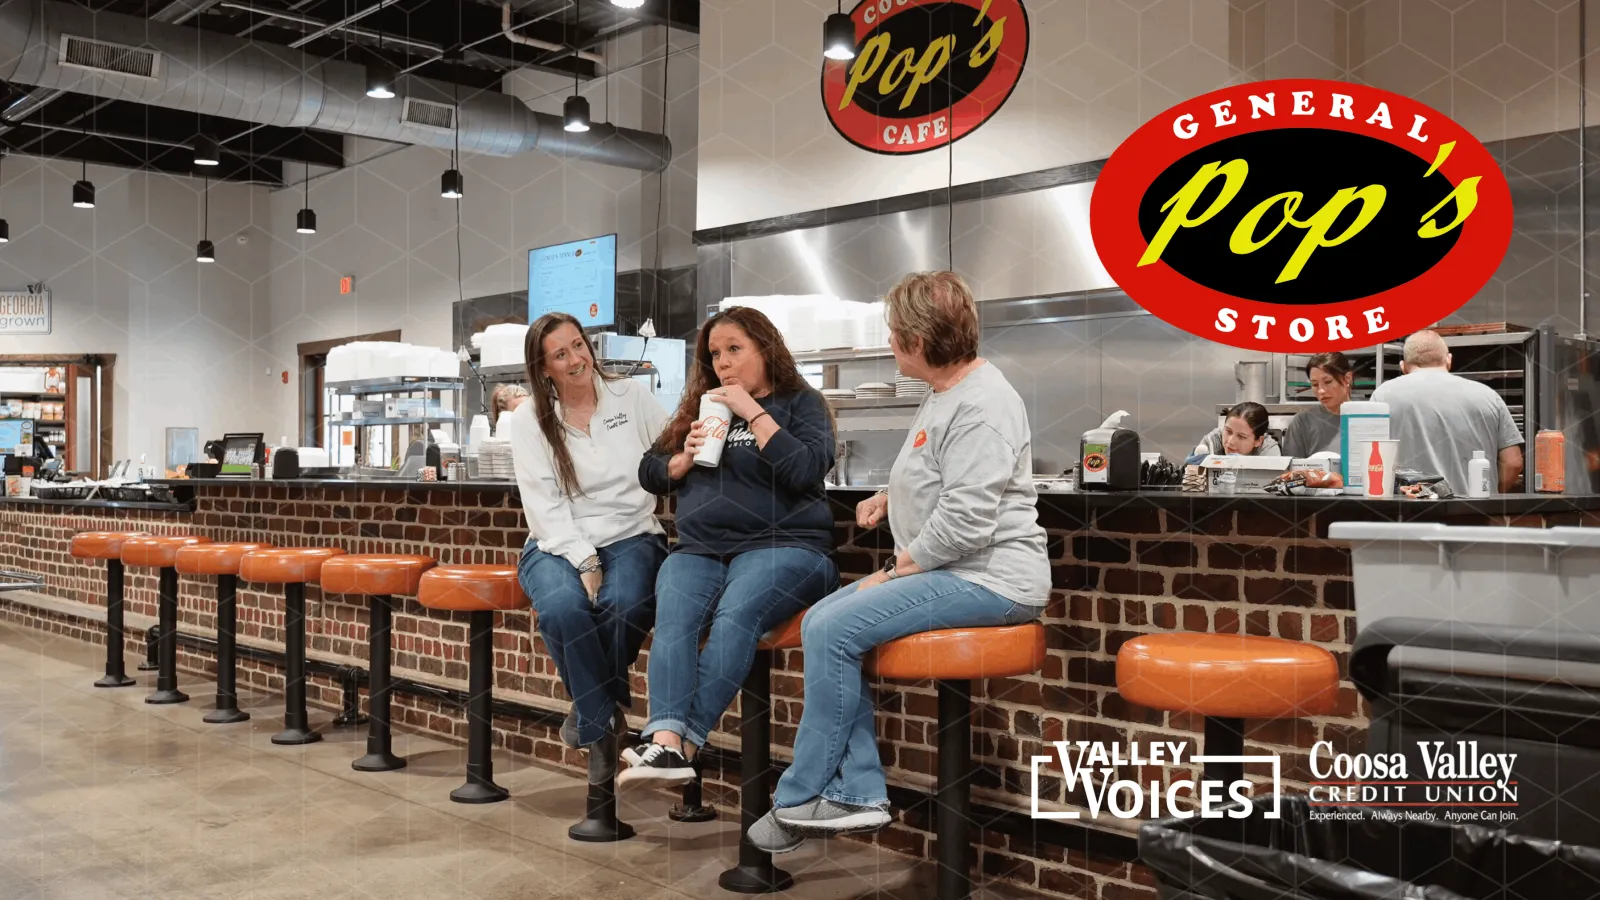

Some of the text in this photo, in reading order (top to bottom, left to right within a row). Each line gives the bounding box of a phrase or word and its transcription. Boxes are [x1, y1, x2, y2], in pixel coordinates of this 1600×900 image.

[883, 117, 948, 145] CAFE
[0, 295, 44, 315] GEORGIA
[0, 317, 45, 328] grown
